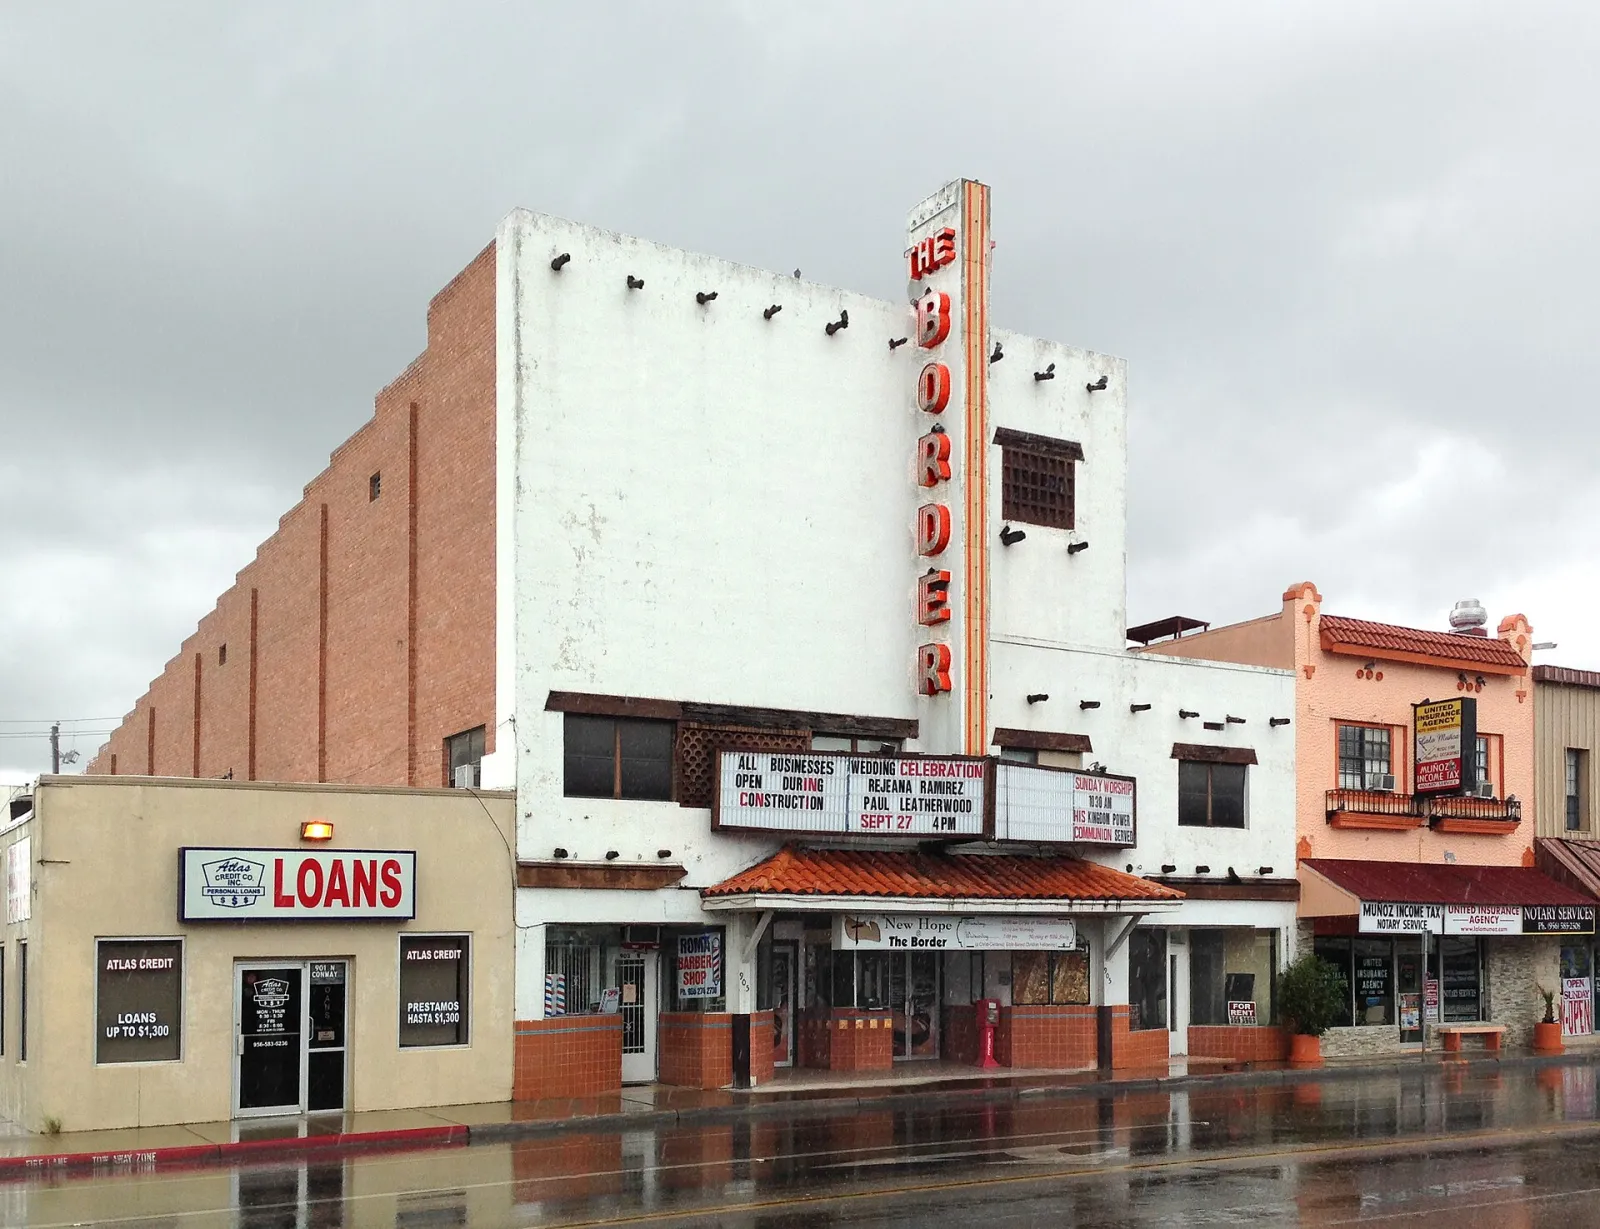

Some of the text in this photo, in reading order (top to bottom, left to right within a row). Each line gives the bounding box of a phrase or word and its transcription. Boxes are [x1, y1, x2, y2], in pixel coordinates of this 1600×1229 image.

[904, 226, 956, 280] THE
[917, 290, 951, 697] BORDER
[1417, 709, 1460, 722] INSURANCE
[1424, 704, 1453, 714] UNITED
[1422, 716, 1455, 728] AGENCY
[738, 756, 834, 775] ALL BUSINESSES
[851, 760, 982, 778] WEDDING CELEBRATION
[1420, 763, 1449, 774] MUÑOZ
[735, 774, 824, 792] OPEN DURING
[1417, 770, 1459, 783] INCOME TAX
[868, 778, 964, 795] REJEANA RAMIREZ
[1075, 777, 1132, 795] SUNDAY WORSHIP
[740, 792, 824, 811] CONSTRUCTION
[864, 797, 972, 813] PAUL LEATHERWOOD
[1104, 797, 1112, 809] AM
[861, 814, 893, 828] SEPT
[897, 815, 913, 829] 27
[1074, 810, 1130, 826] HIS KINGDOM POWER
[1074, 827, 1133, 843] COMMUNION SERVED
[215, 873, 254, 882] CREDIT CO.
[216, 858, 402, 908] Atlas LOANS
[1363, 903, 1440, 918] MUNOZ INCOME TAX
[1448, 906, 1520, 916] UNITED INSURANCE
[1524, 907, 1594, 920] NOTARY SERVICES
[885, 918, 952, 933] New Hope
[1377, 919, 1427, 930] NOTARY SERVICE
[1469, 915, 1500, 924] AGENCY
[680, 936, 711, 954] ROMA
[889, 936, 947, 948] The Border
[407, 950, 461, 960] ATLAS CREDIT
[107, 958, 173, 970] ATLAS CREDIT
[679, 955, 712, 970] BARBER
[1363, 958, 1382, 966] UNITED
[683, 971, 706, 985] SHOP
[1104, 967, 1112, 984] 905
[1357, 970, 1388, 978] INSURANCE
[739, 972, 750, 992] 905
[1362, 980, 1384, 989] AGENCY
[1567, 979, 1584, 988] OPEN
[1564, 990, 1589, 1000] SUNDAY
[408, 1002, 459, 1012] PRESTAMOS
[118, 1013, 156, 1024] LOANS
[408, 1013, 459, 1024] HASTA $1,300
[107, 1025, 169, 1038] UP TO $1,300
[136, 1152, 157, 1163] ZONE
